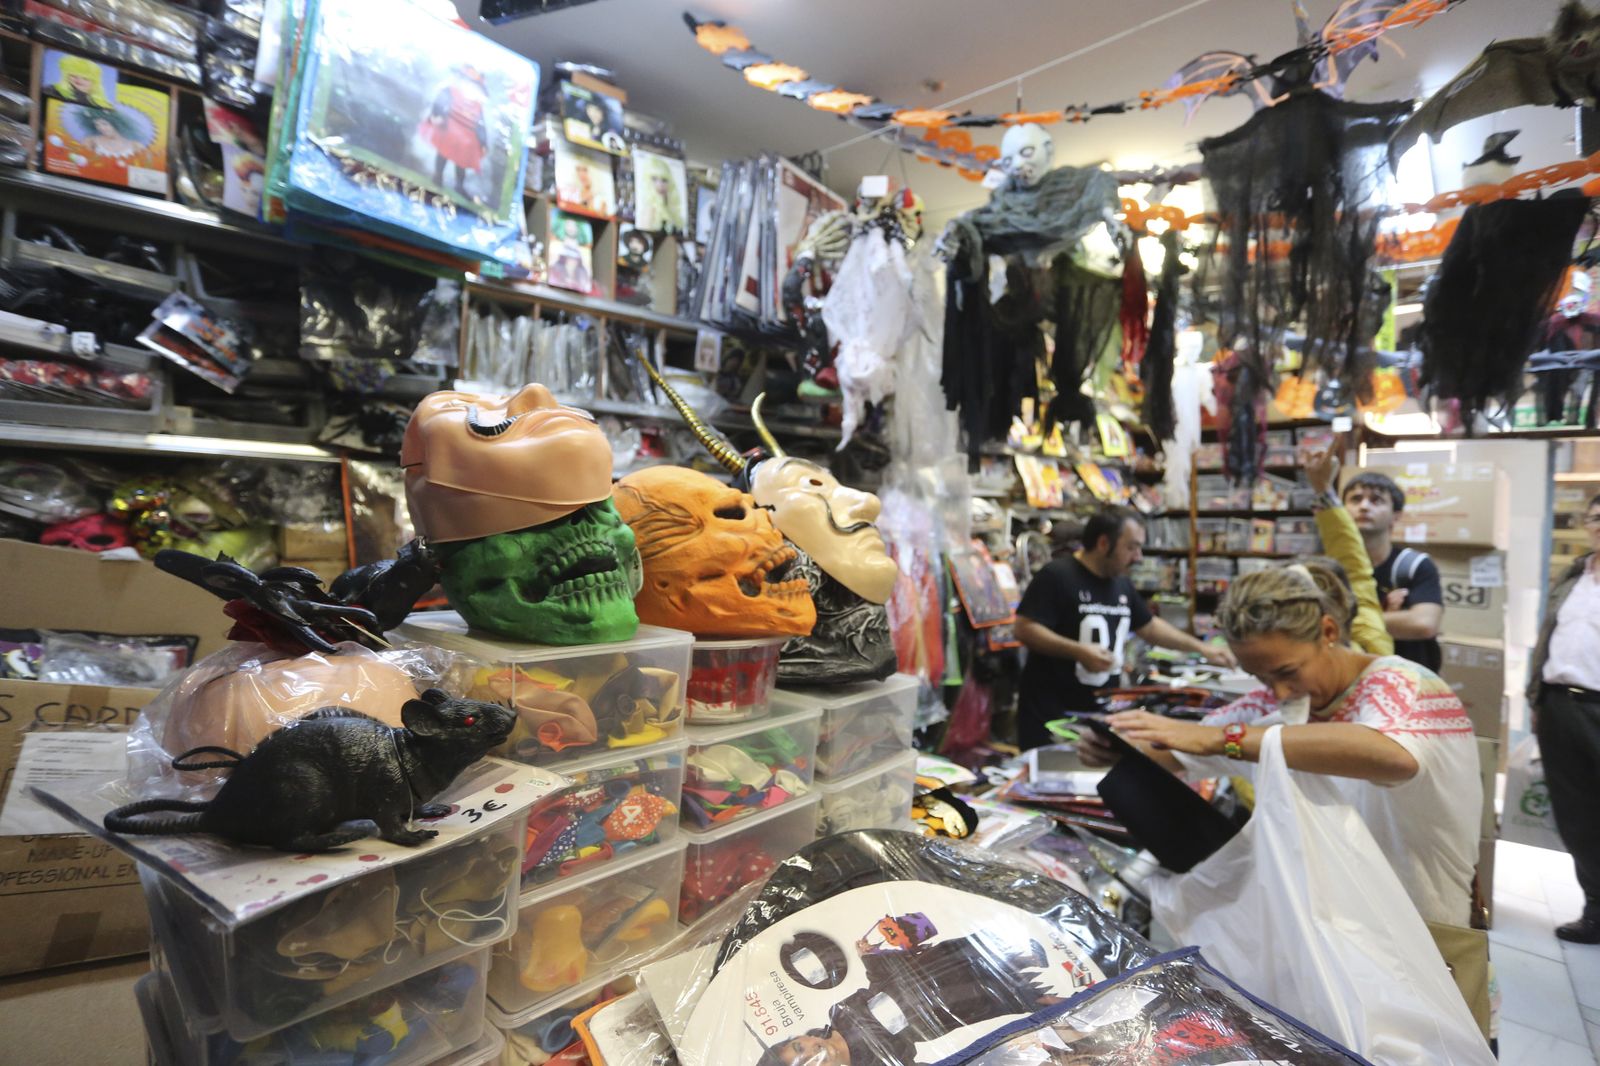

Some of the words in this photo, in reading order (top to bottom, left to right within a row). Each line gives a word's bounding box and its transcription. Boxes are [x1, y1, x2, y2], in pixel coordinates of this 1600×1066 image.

[461, 799, 507, 823] 3€
[745, 991, 779, 1036] 91.645
[769, 970, 805, 1021] vampiresa
[772, 999, 794, 1028] Bruja
